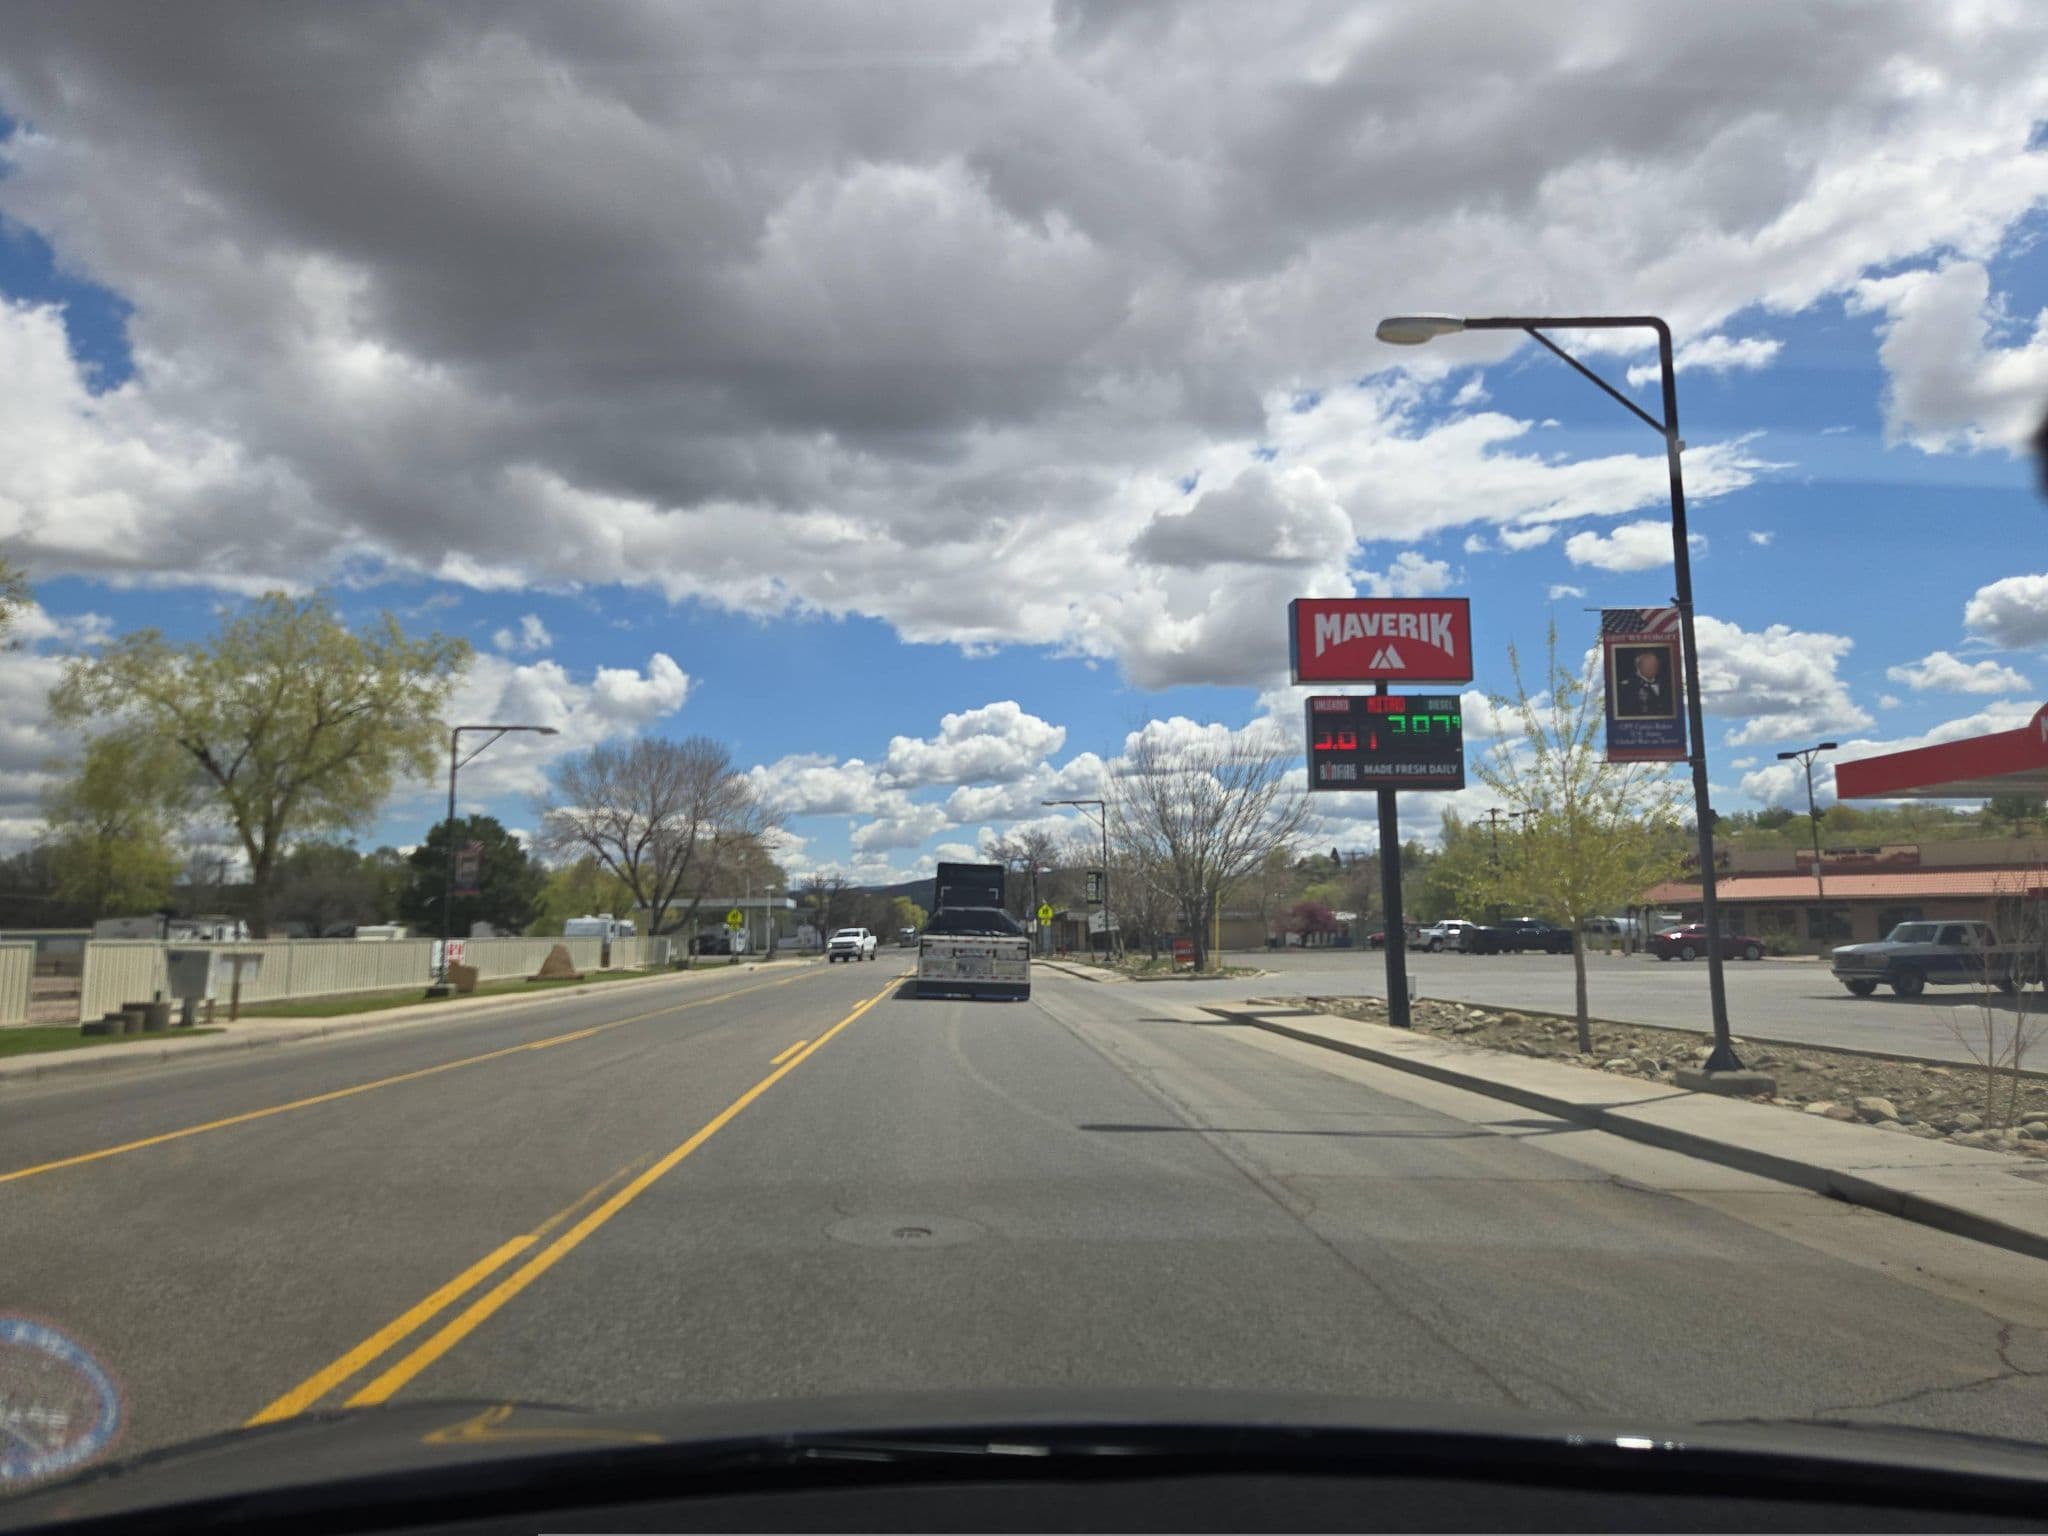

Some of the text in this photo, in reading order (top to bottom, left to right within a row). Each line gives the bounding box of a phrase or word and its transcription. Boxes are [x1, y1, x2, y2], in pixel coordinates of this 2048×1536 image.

[1314, 612, 1455, 658] MAVERIK
[1363, 763, 1457, 774] MADE FRESH DAILY
